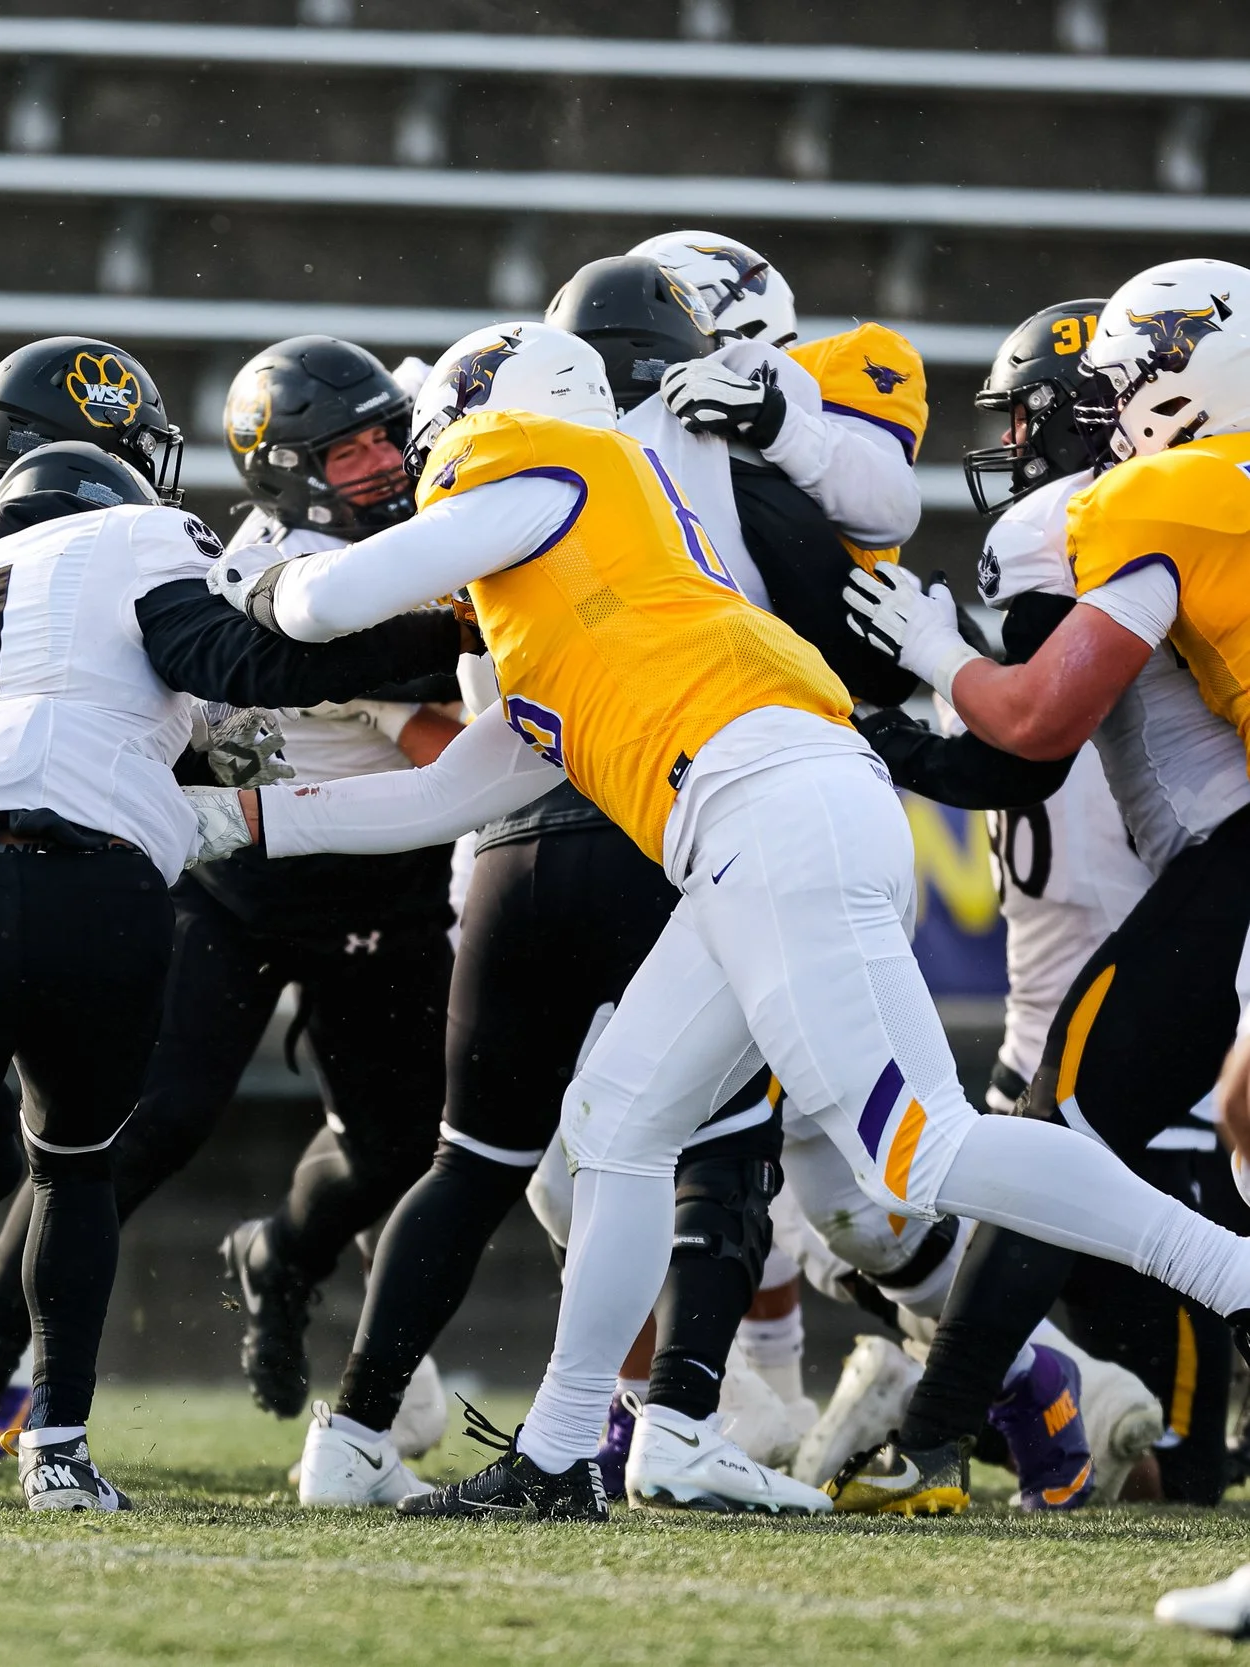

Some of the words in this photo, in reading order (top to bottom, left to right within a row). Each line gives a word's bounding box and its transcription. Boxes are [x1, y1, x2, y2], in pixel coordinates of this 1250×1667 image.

[84, 383, 133, 405] WSC
[1043, 1389, 1078, 1437] NIKE
[716, 1459, 749, 1474] ALPHA
